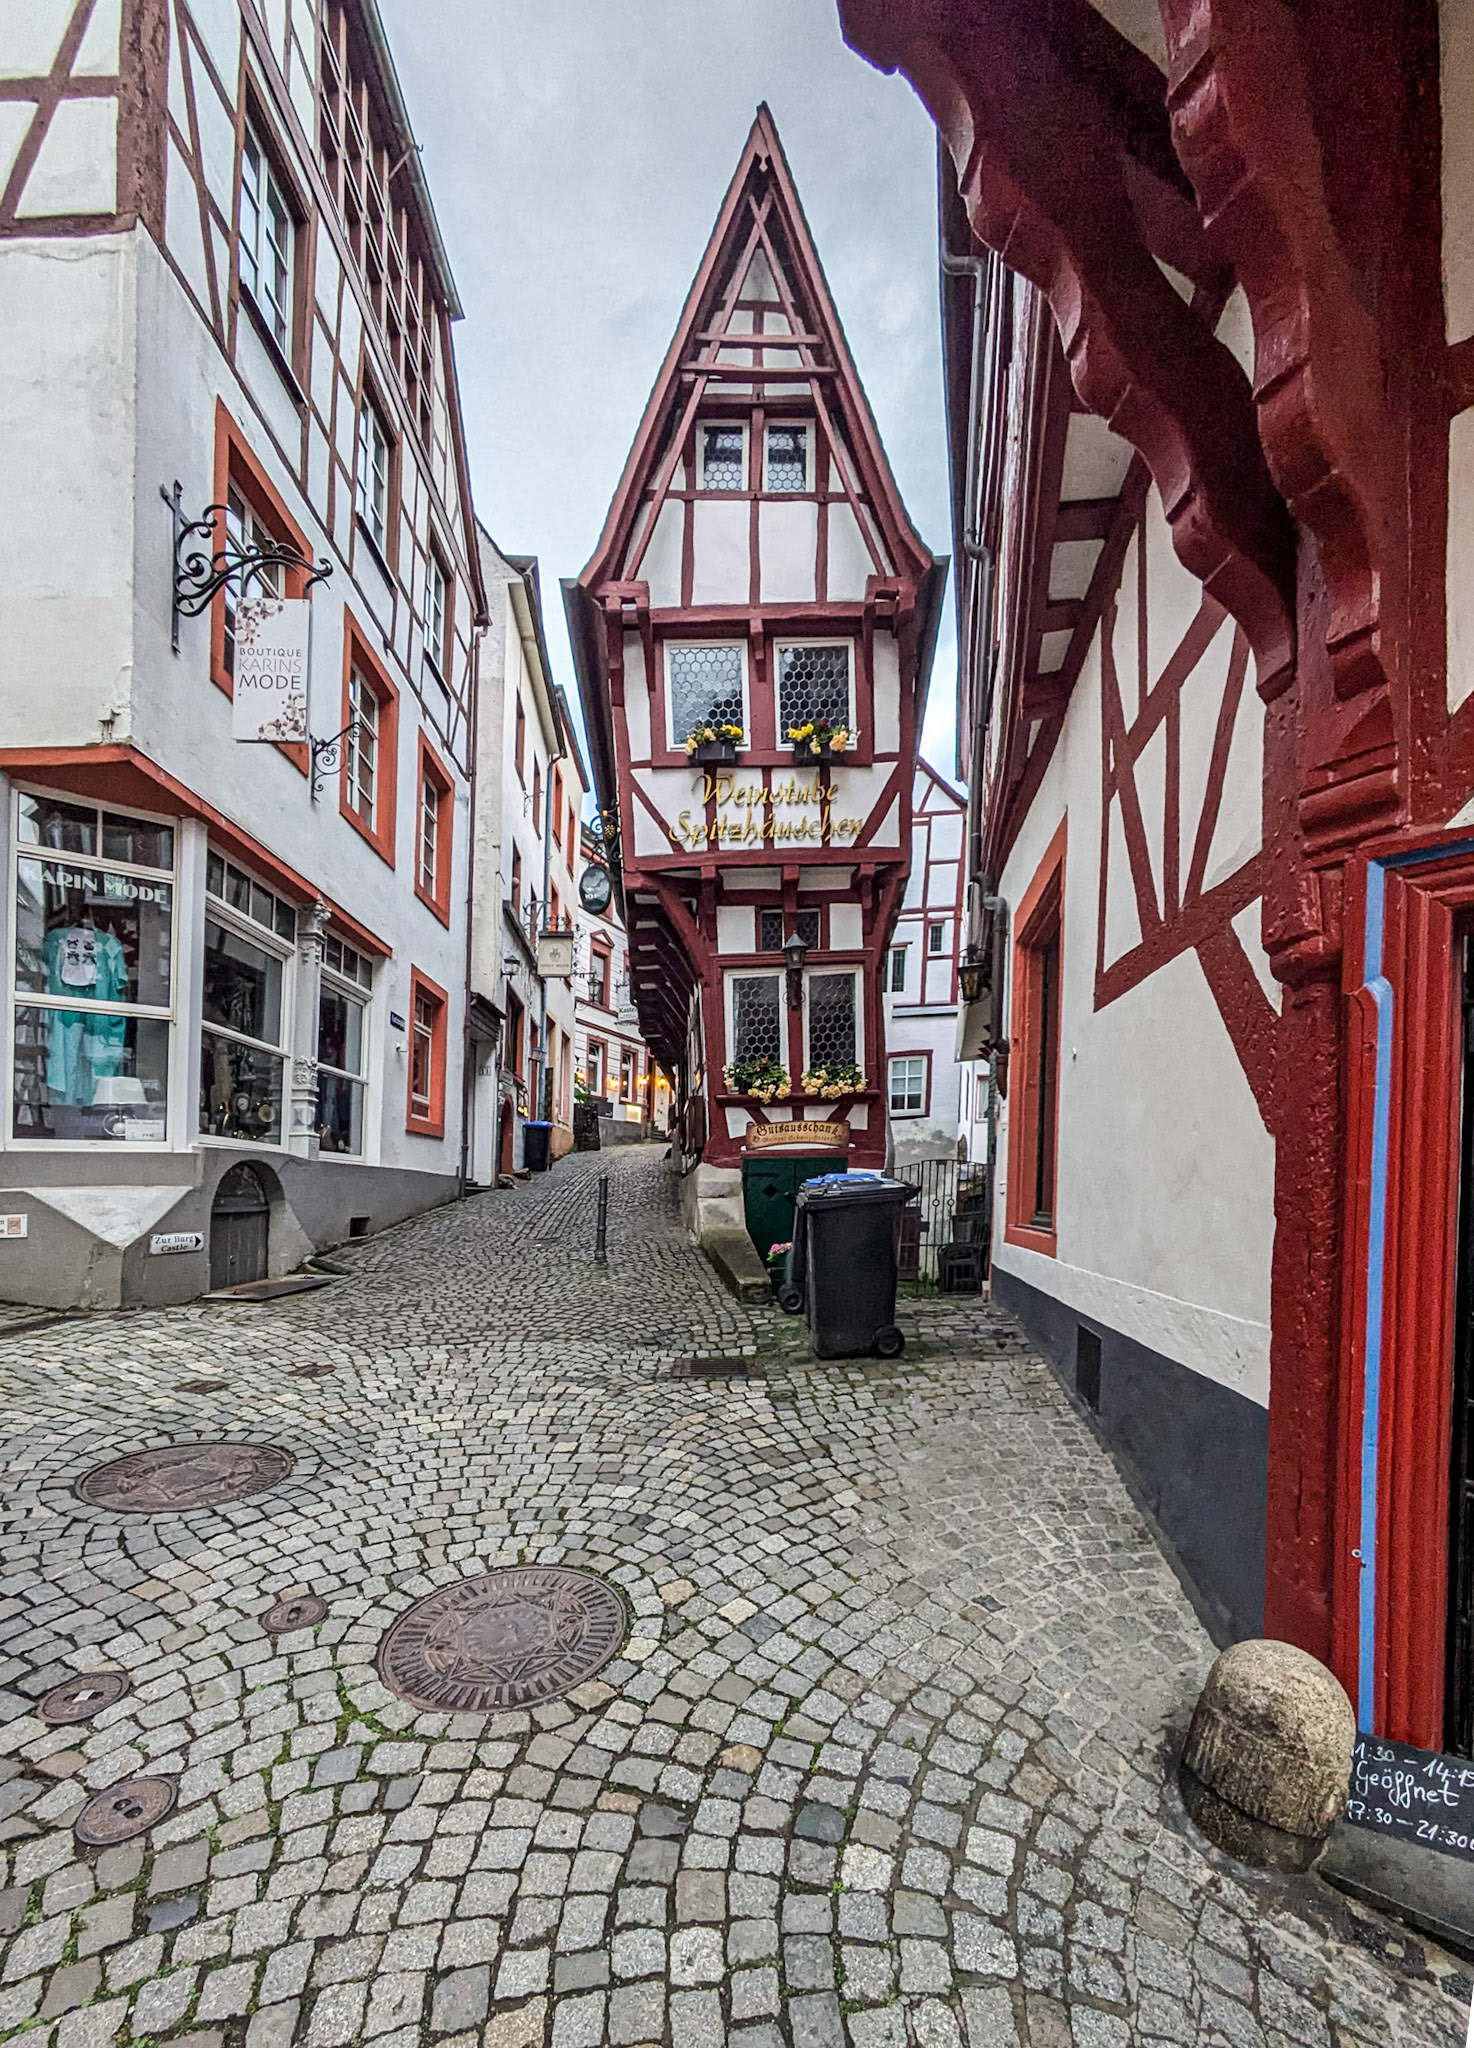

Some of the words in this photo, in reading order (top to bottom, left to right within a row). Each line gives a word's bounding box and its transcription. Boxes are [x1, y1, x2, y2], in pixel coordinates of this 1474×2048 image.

[239, 647, 302, 657] BOUTIQUE
[238, 658, 302, 674] KARINS
[239, 674, 301, 690] MODE
[692, 772, 839, 807] Weinstube
[668, 804, 864, 848] Spitzhäuschen
[22, 866, 98, 892] KARIN
[103, 881, 168, 904] MODE
[756, 1121, 839, 1136] Gutsausschank
[155, 1236, 172, 1244] Zur
[174, 1235, 194, 1243] Burg
[161, 1244, 188, 1252] Castle
[1356, 1760, 1460, 1809] Geöffnet
